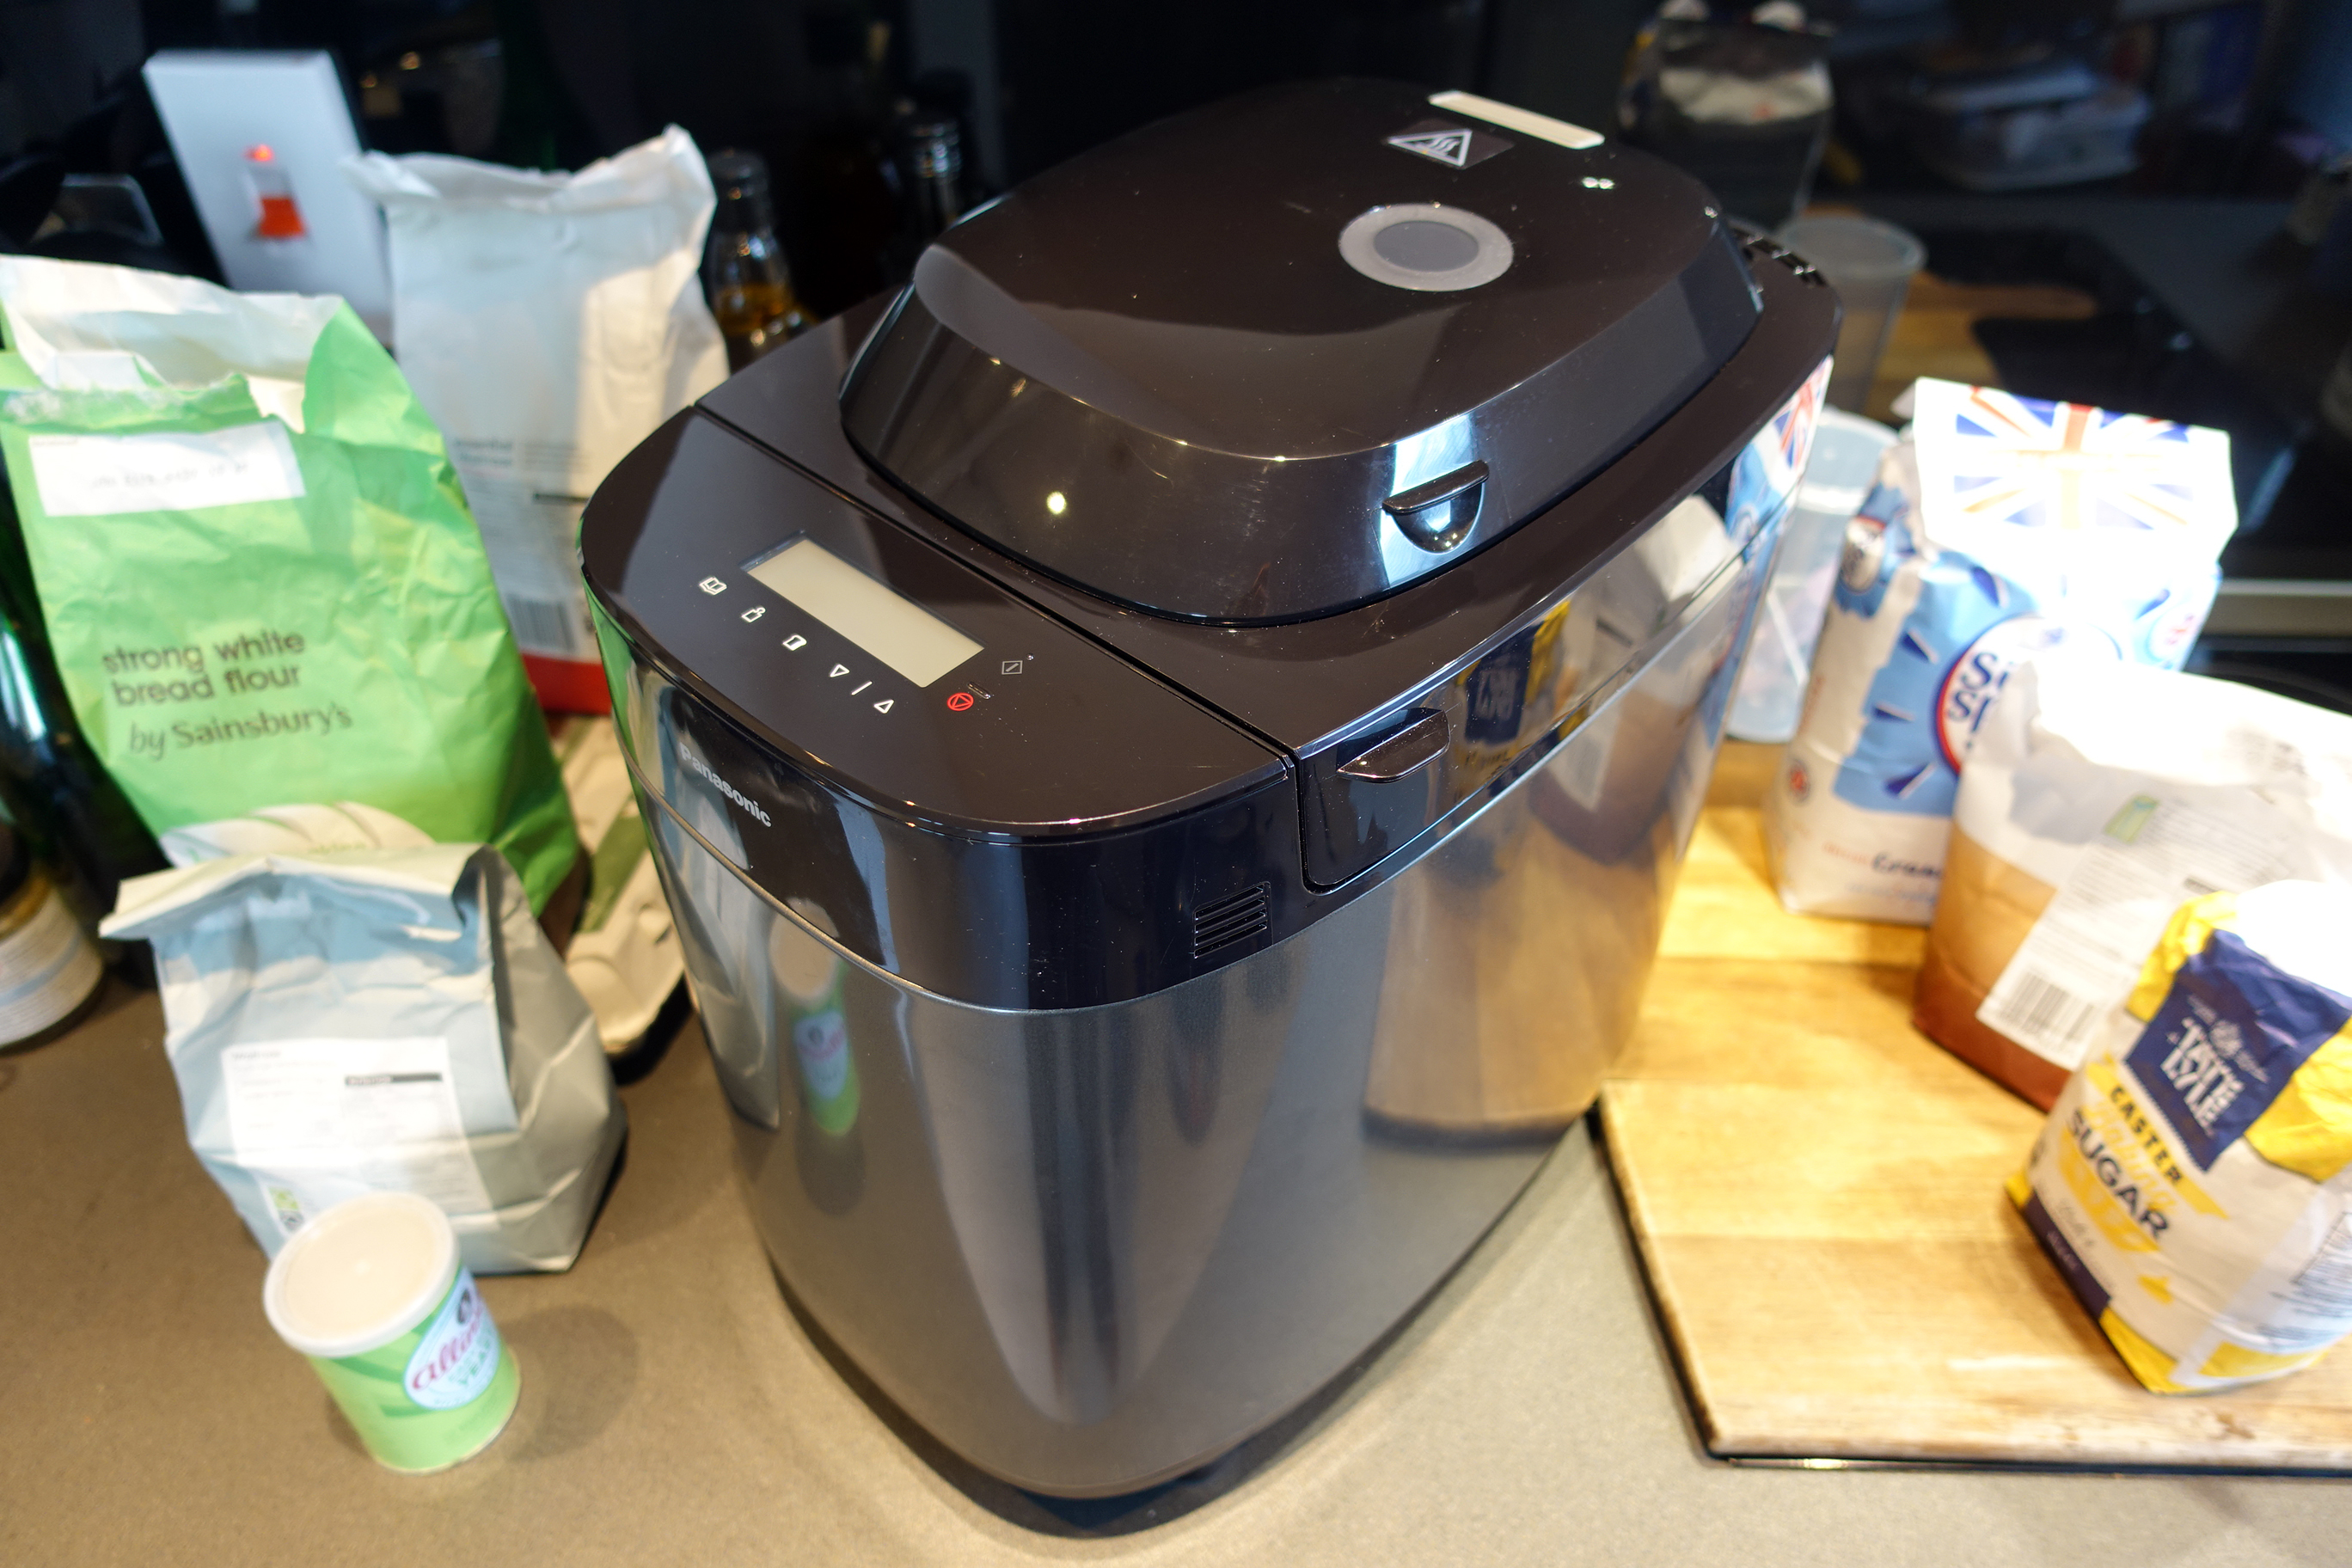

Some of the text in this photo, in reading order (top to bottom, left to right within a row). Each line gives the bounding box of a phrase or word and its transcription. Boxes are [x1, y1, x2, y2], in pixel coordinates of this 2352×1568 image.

[102, 629, 306, 673] strong white
[111, 665, 301, 707] bread flour
[130, 701, 353, 762] by Sainsbury's
[680, 742, 772, 828] Panasonic
[2110, 1086, 2184, 1186] CASTER
[2072, 1107, 2170, 1240] SUGAR
